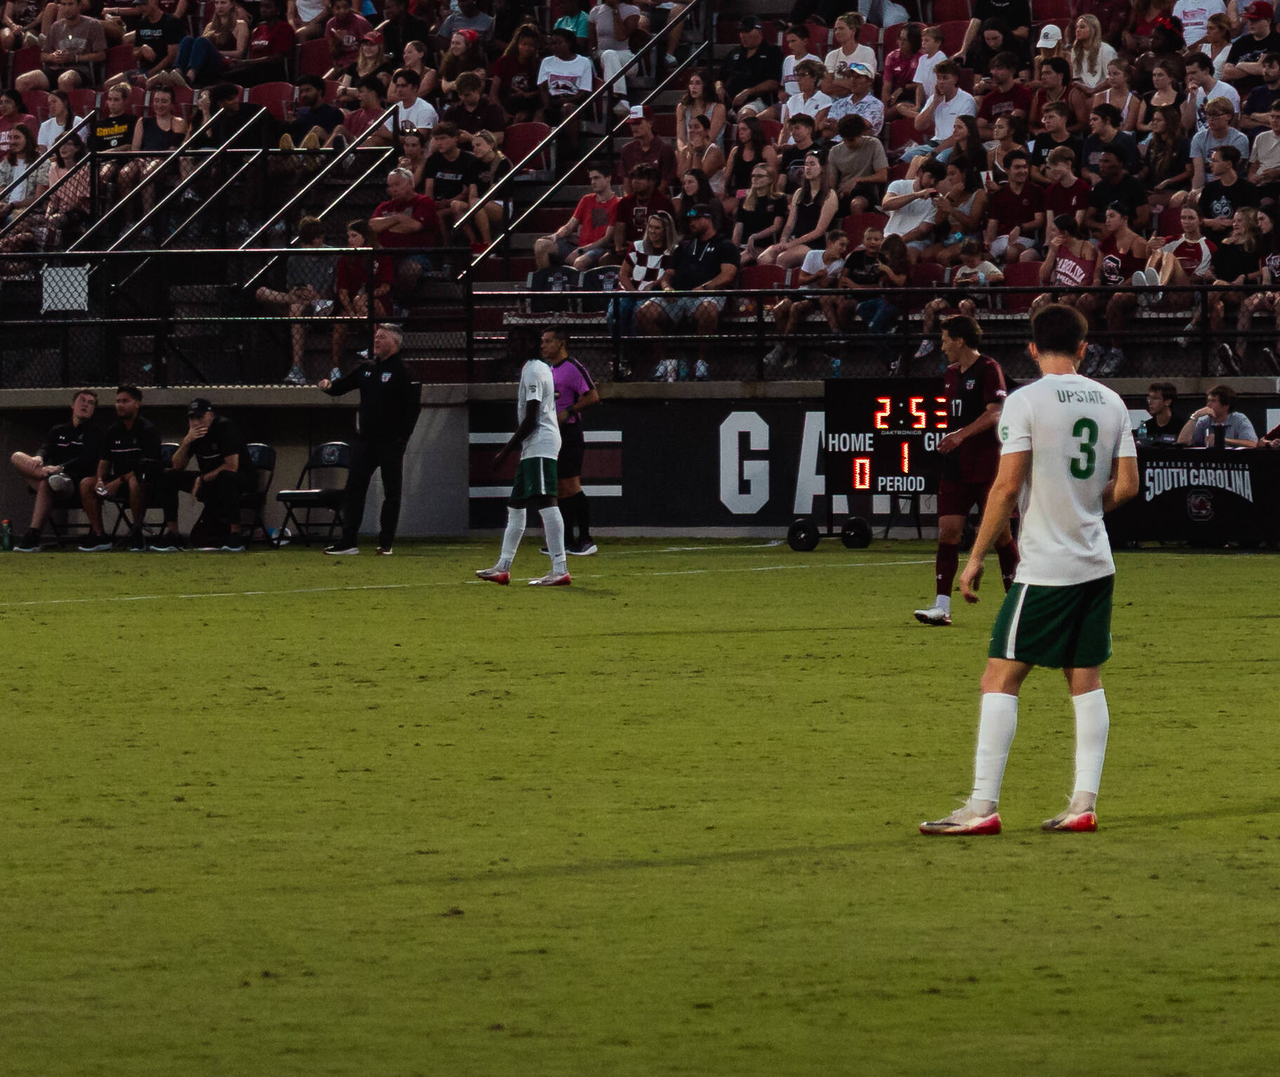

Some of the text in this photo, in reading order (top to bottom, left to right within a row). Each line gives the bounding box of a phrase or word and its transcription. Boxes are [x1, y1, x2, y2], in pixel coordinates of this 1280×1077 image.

[950, 398, 963, 418] 17
[1056, 388, 1107, 406] UPSTATE
[827, 433, 875, 452] HOME
[1071, 417, 1099, 481] 3
[900, 442, 909, 474] 1
[853, 457, 871, 490] 0
[877, 476, 926, 494] PERIOD
[1144, 467, 1255, 504] SOUTH CAROLINA
